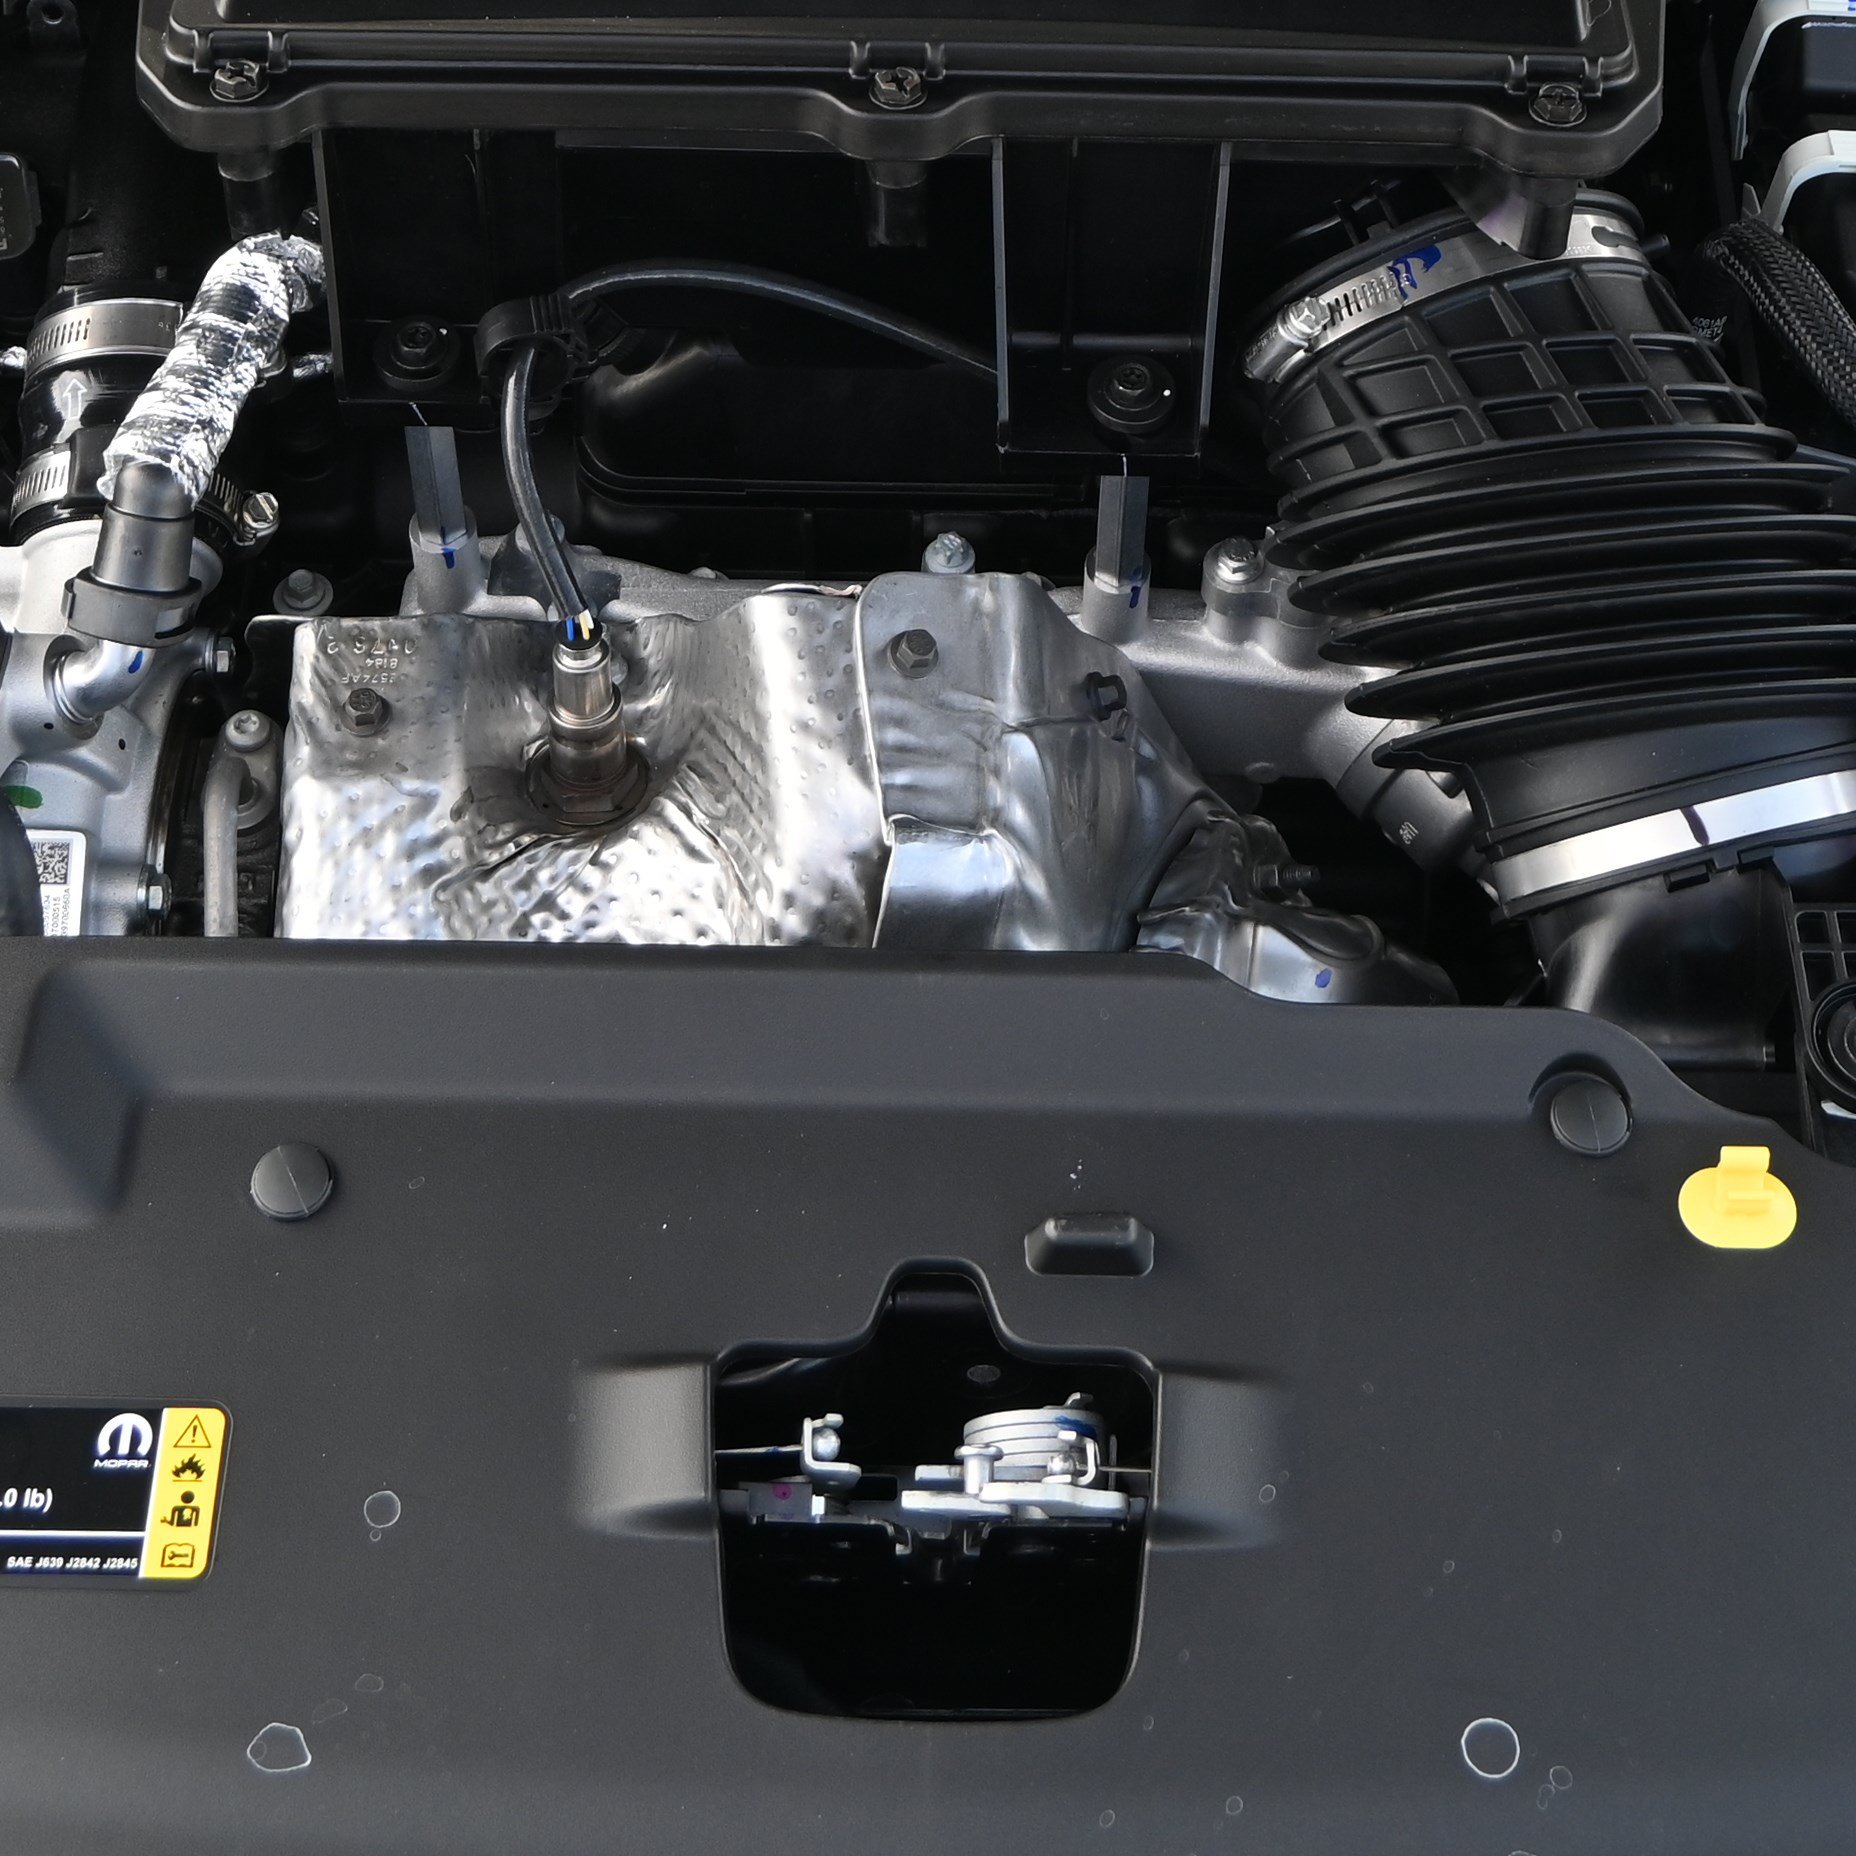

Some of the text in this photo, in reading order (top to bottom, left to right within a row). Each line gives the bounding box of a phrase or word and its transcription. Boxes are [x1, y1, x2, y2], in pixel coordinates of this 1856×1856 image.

[24, 1488, 53, 1513] lb)
[7, 1556, 138, 1570] SAE J639 J2842 J2845
